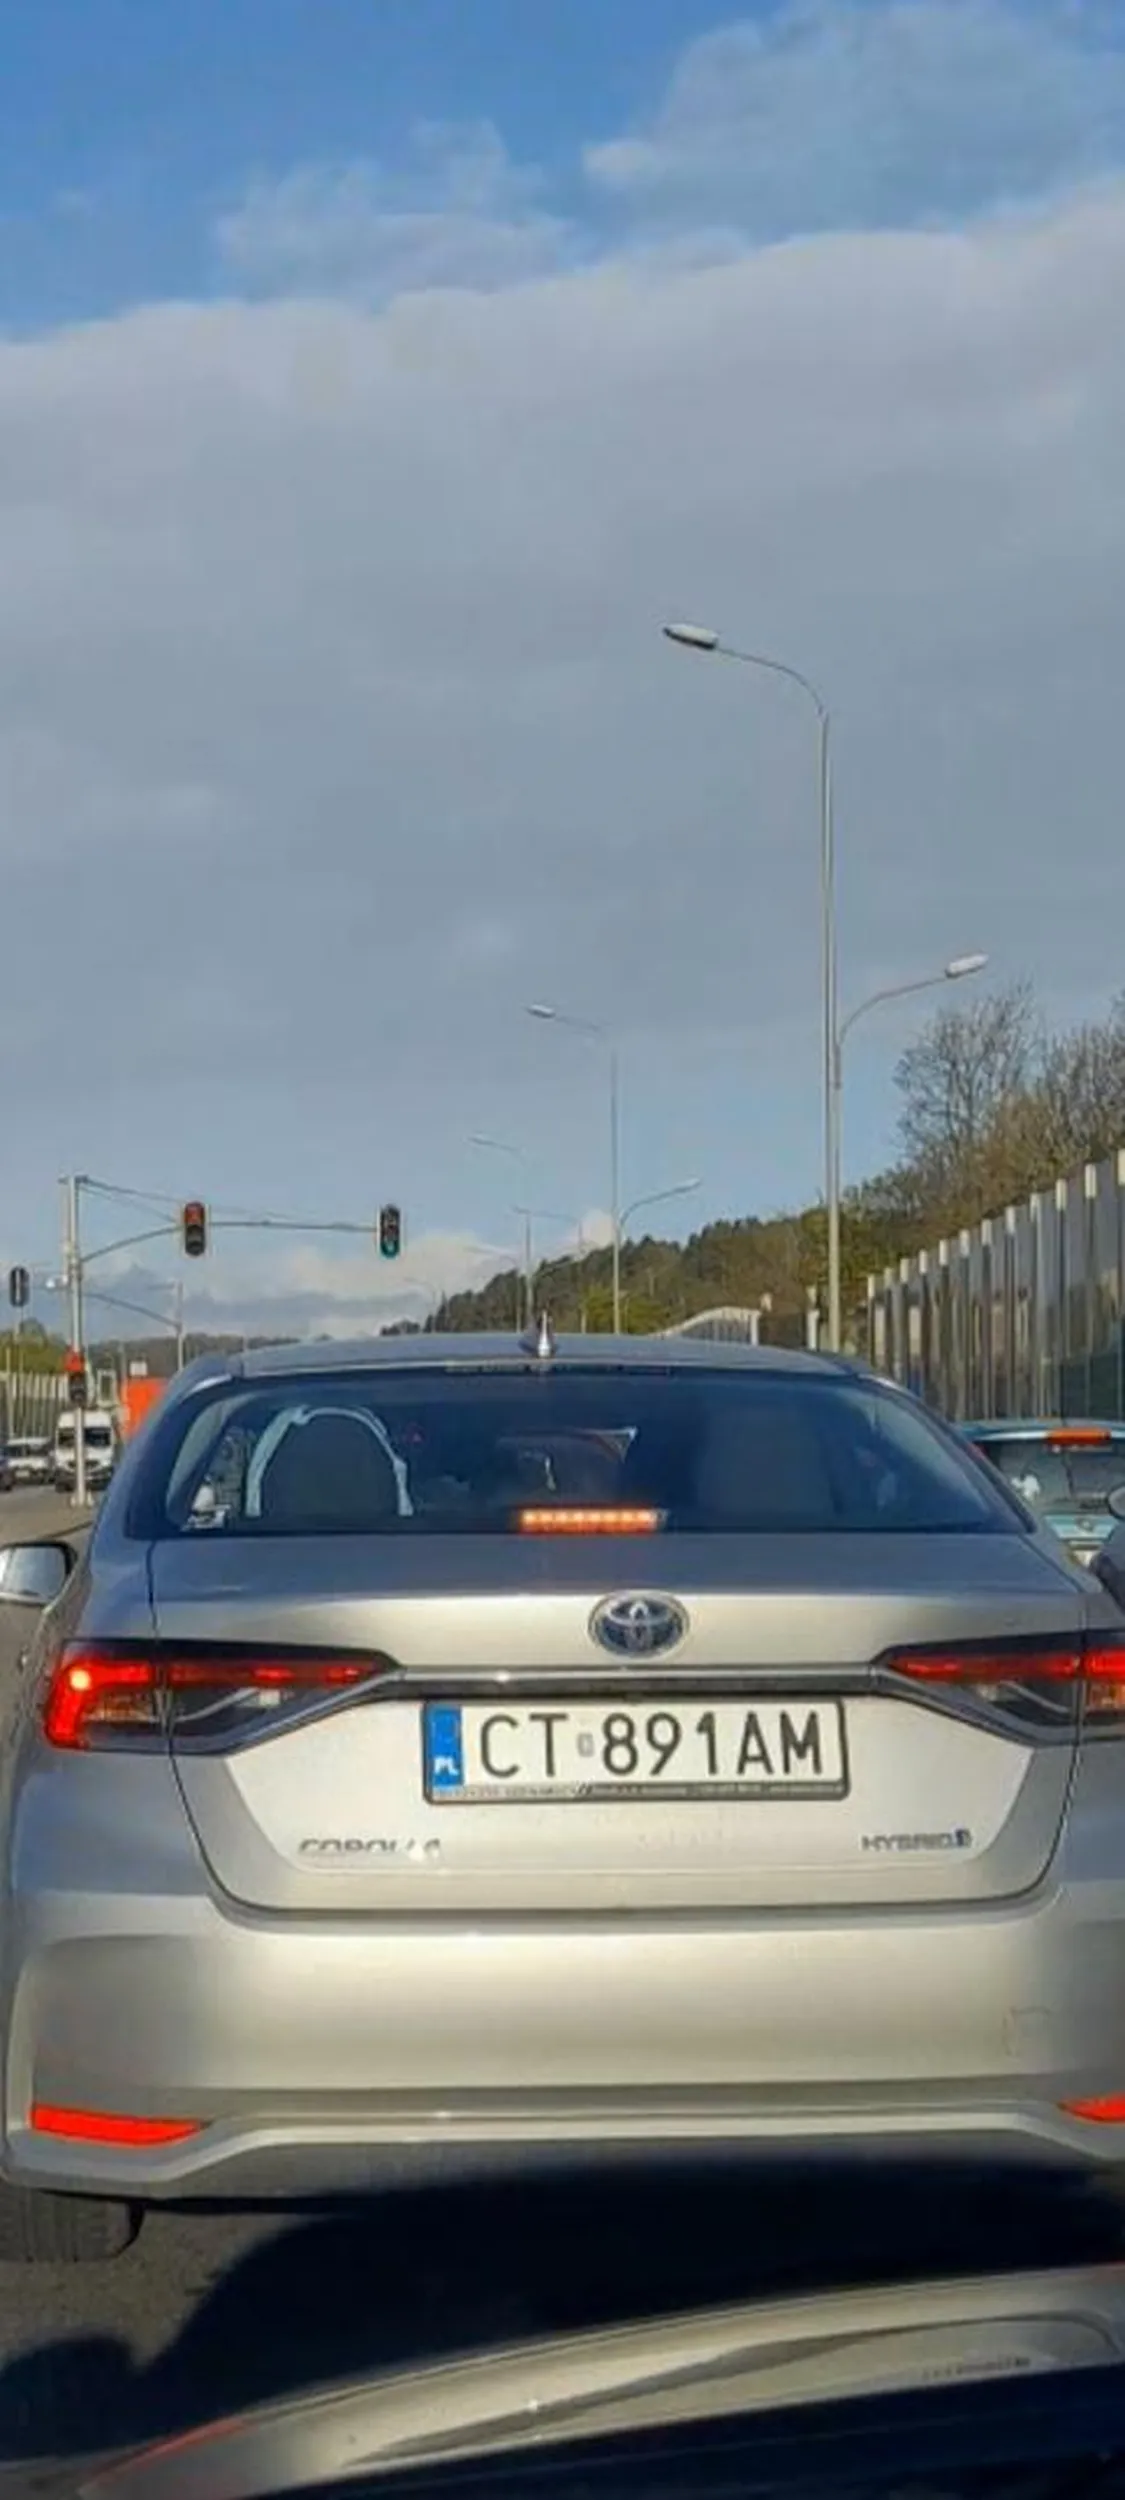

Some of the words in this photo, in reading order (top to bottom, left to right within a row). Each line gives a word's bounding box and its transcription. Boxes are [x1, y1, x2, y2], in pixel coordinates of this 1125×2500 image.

[480, 1712, 569, 1778] CT
[602, 1711, 823, 1776] 891AM
[434, 1756, 459, 1776] PL
[861, 1832, 953, 1851] HYBRID
